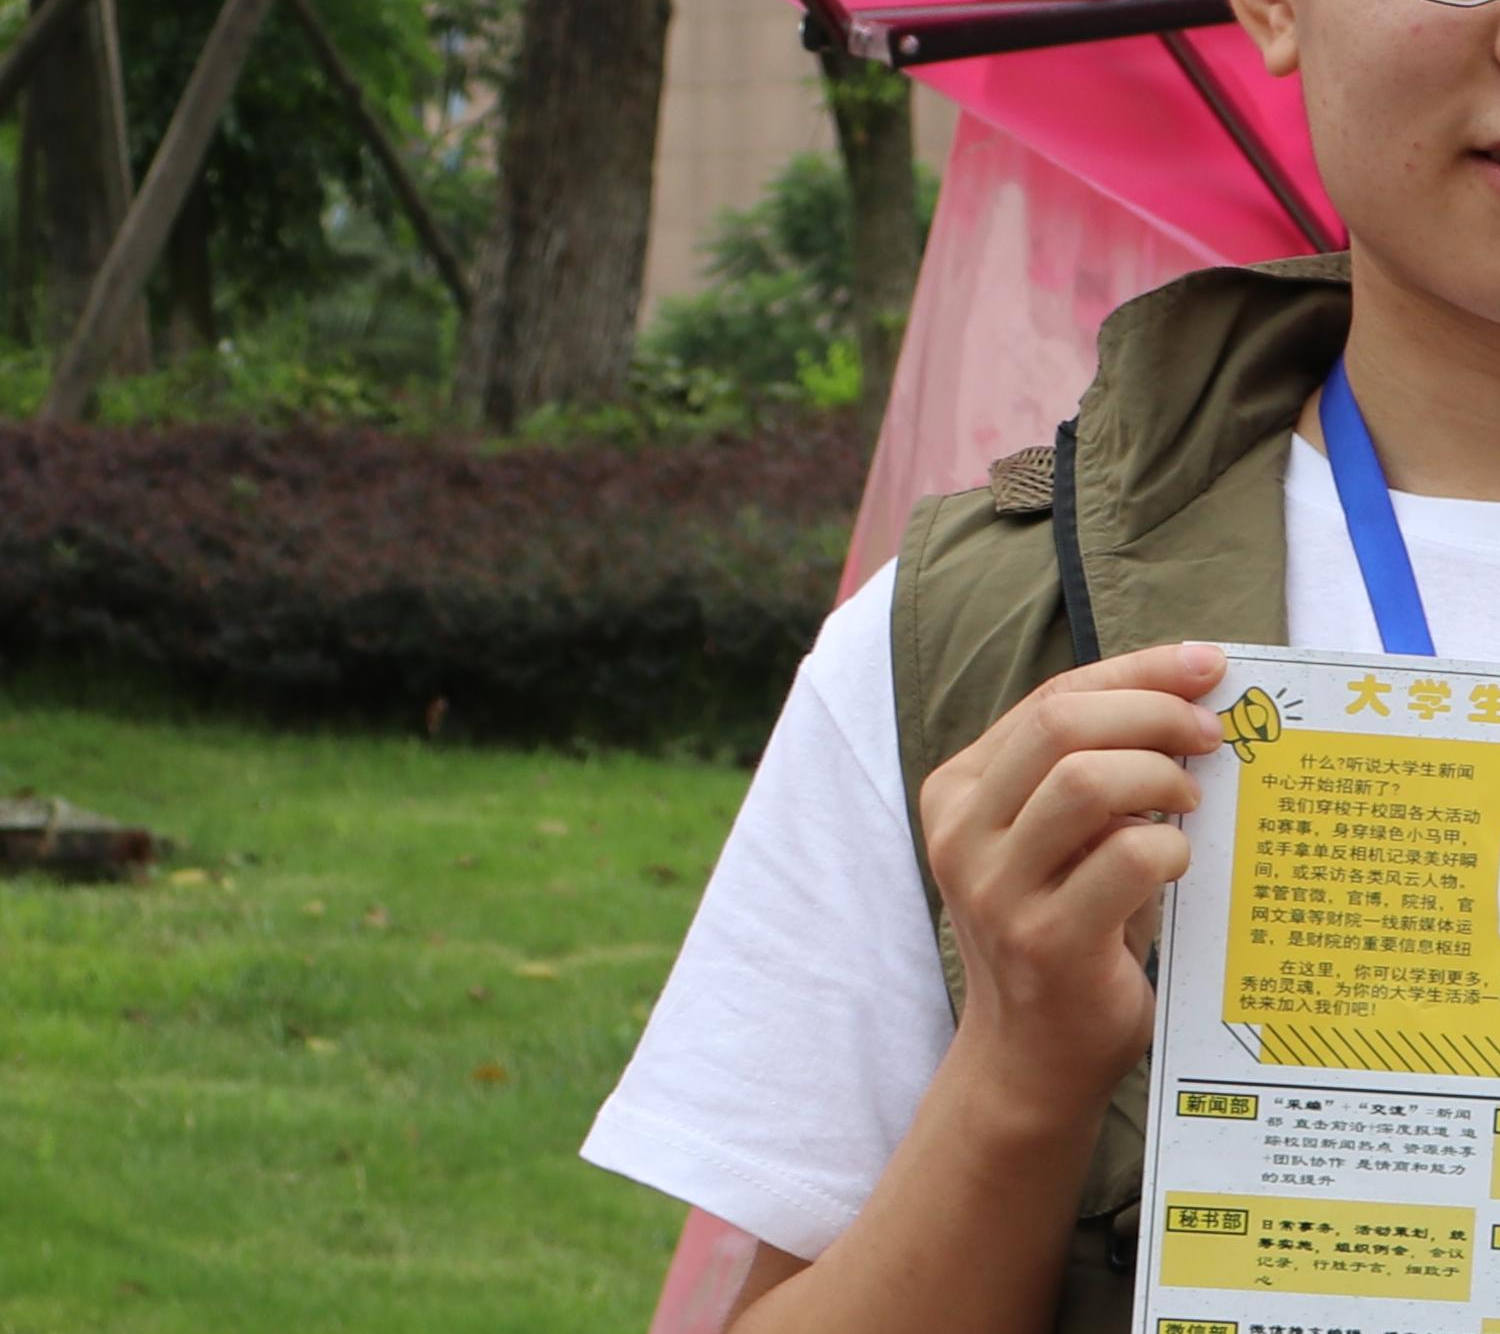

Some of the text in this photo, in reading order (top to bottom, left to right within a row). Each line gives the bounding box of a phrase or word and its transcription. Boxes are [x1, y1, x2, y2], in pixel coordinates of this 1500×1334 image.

[1278, 796, 1481, 825] 我们穿梭于校园各大活动
[1256, 840, 1479, 869] 或手拿单反相机记录美好瞬
[1251, 906, 1473, 935] 网文章等财院一线新媒体运
[1186, 1094, 1250, 1116] 新闻部
[1179, 1209, 1242, 1231] 秘书部
